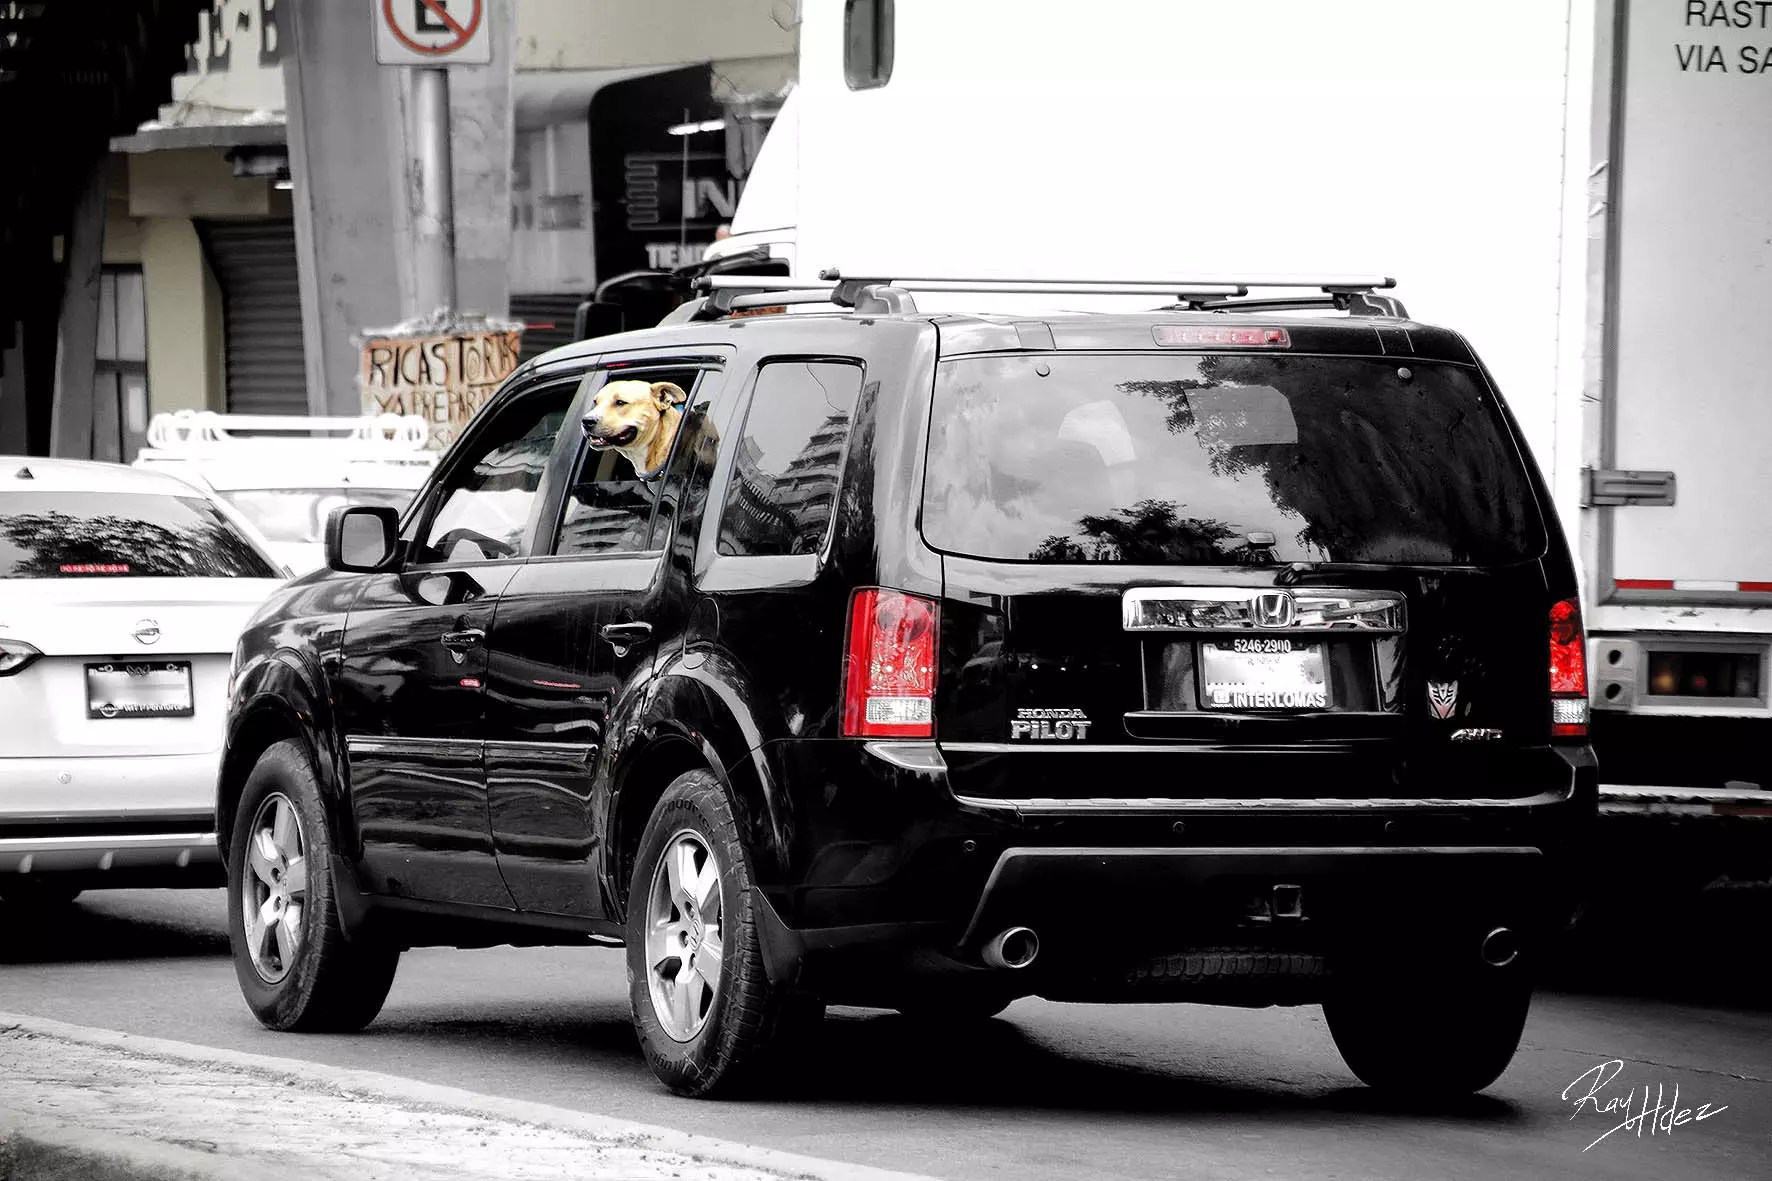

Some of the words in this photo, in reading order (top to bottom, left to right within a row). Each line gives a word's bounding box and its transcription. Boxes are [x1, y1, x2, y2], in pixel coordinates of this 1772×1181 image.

[1686, 0, 1772, 28] RAST
[1674, 44, 1728, 73] VIA
[368, 341, 449, 388] RICAS
[1017, 708, 1088, 719] HONDA
[1233, 692, 1327, 708] INTERLOMAS
